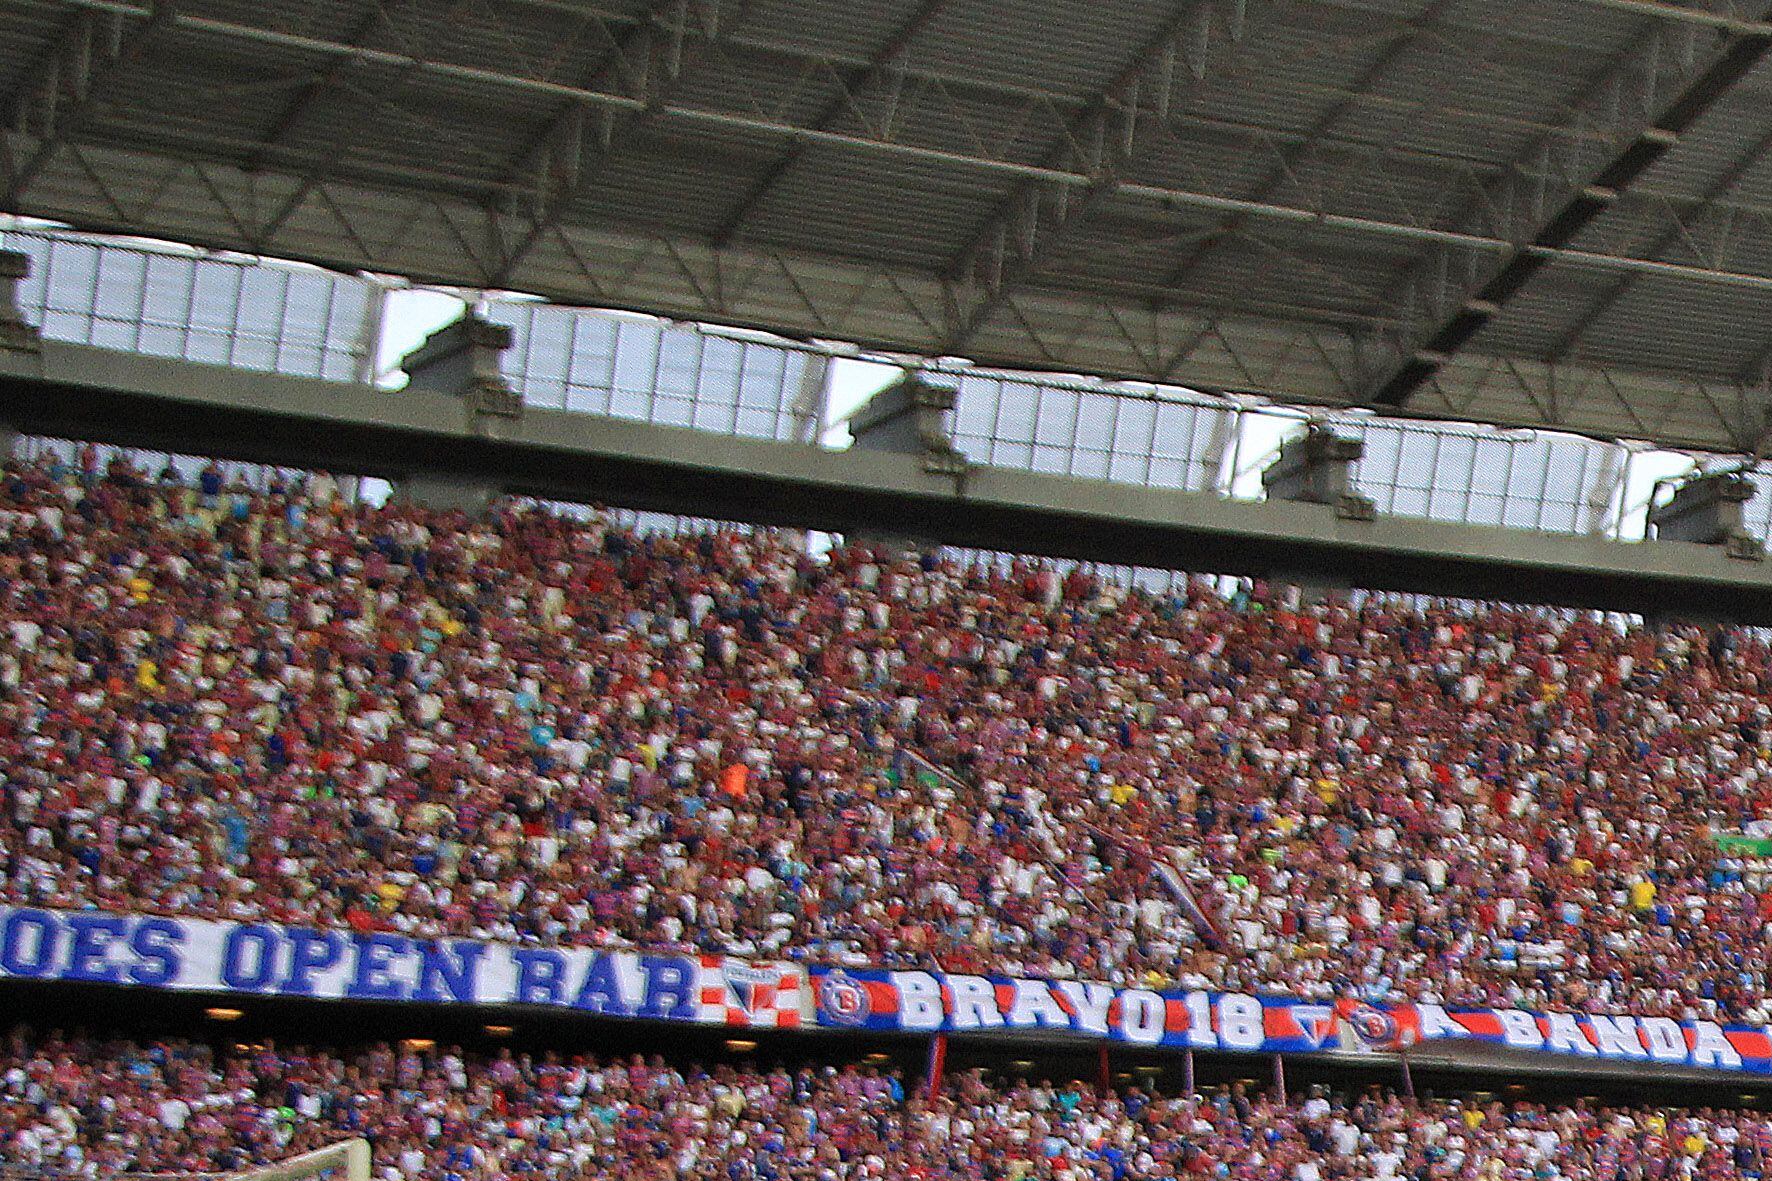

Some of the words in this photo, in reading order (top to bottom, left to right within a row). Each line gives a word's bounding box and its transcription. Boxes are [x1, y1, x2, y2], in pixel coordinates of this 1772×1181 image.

[224, 922, 488, 1002] OPEN
[515, 945, 700, 1020] BAR
[893, 971, 1166, 1043] BRAVO
[1185, 991, 1265, 1049] 18
[1415, 1003, 1473, 1037] A
[1492, 1008, 1743, 1067] BANDA
